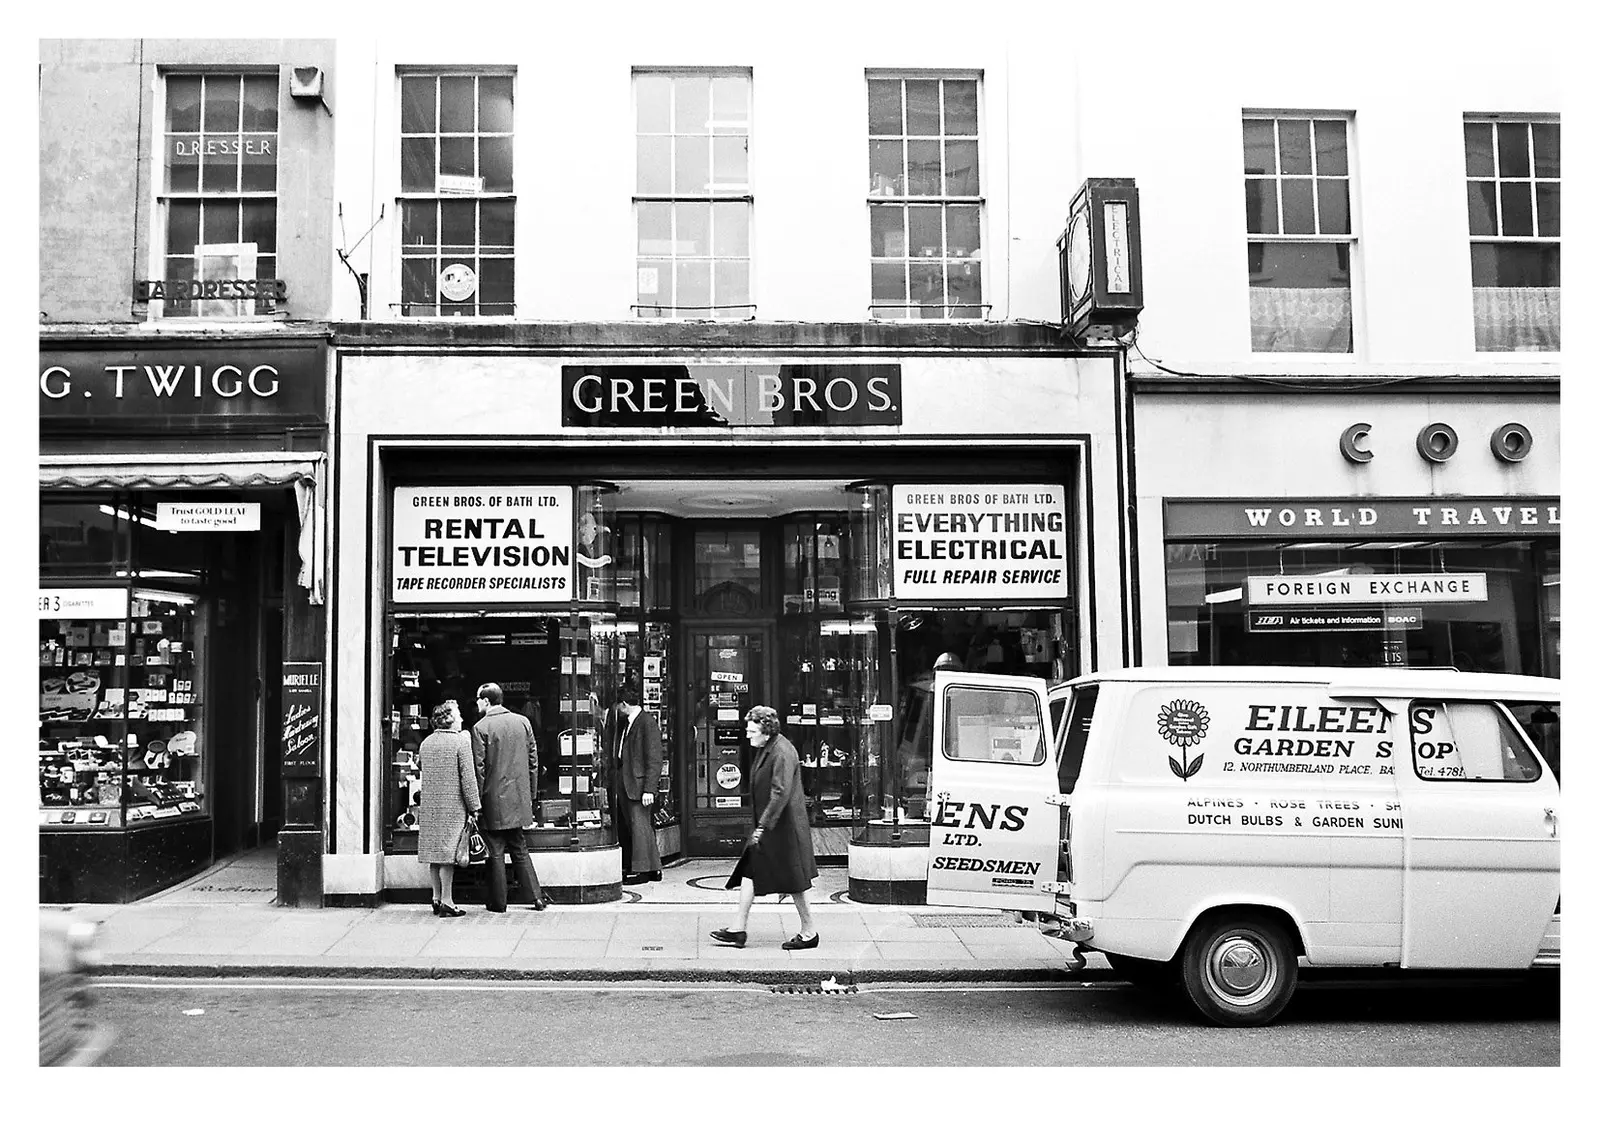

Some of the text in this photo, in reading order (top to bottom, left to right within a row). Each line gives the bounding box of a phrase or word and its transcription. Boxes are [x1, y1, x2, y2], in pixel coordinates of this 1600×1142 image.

[40, 365, 278, 398] G. TWIGG
[571, 374, 898, 413] GREEN BROS.
[413, 496, 558, 507] GREEN BROS. OF BATH LTD.
[907, 494, 1056, 504] GREEN BROS OF BATH LTD.
[172, 507, 193, 515] Trust
[195, 507, 222, 515] GOLD
[1245, 507, 1560, 527] WORLD TRAVEL
[425, 519, 544, 539] RENTAL
[898, 513, 1062, 532] EVERYTHING
[398, 546, 568, 566] TELEVISION
[898, 540, 1062, 559] ELECTRICAL
[397, 577, 565, 589] TAPE RECORDER SPECIALISTS
[904, 570, 1061, 583] FULL REPAIR SERVICE
[1267, 581, 1469, 595] FOREIGN EXCHANGE
[54, 596, 60, 611] 3
[1290, 616, 1300, 625] Air
[1302, 616, 1325, 625] tickets
[1327, 616, 1338, 625] and
[1341, 616, 1381, 624] information
[717, 673, 738, 681] OPEN
[1234, 738, 1454, 759] GARDEN SOP
[1240, 763, 1334, 773] NORTHUMBERLAND
[1419, 766, 1435, 777] Tel.
[1187, 798, 1244, 809] ALPINES
[1270, 800, 1306, 810] ROSE
[1316, 800, 1360, 811] TREES
[1188, 815, 1231, 824] DUTCH
[1242, 816, 1283, 826] BULBS
[1295, 817, 1302, 826] &
[1313, 817, 1363, 827] GARDEN
[943, 834, 982, 846] LTD.
[932, 857, 1041, 875] SEEDSMEN
